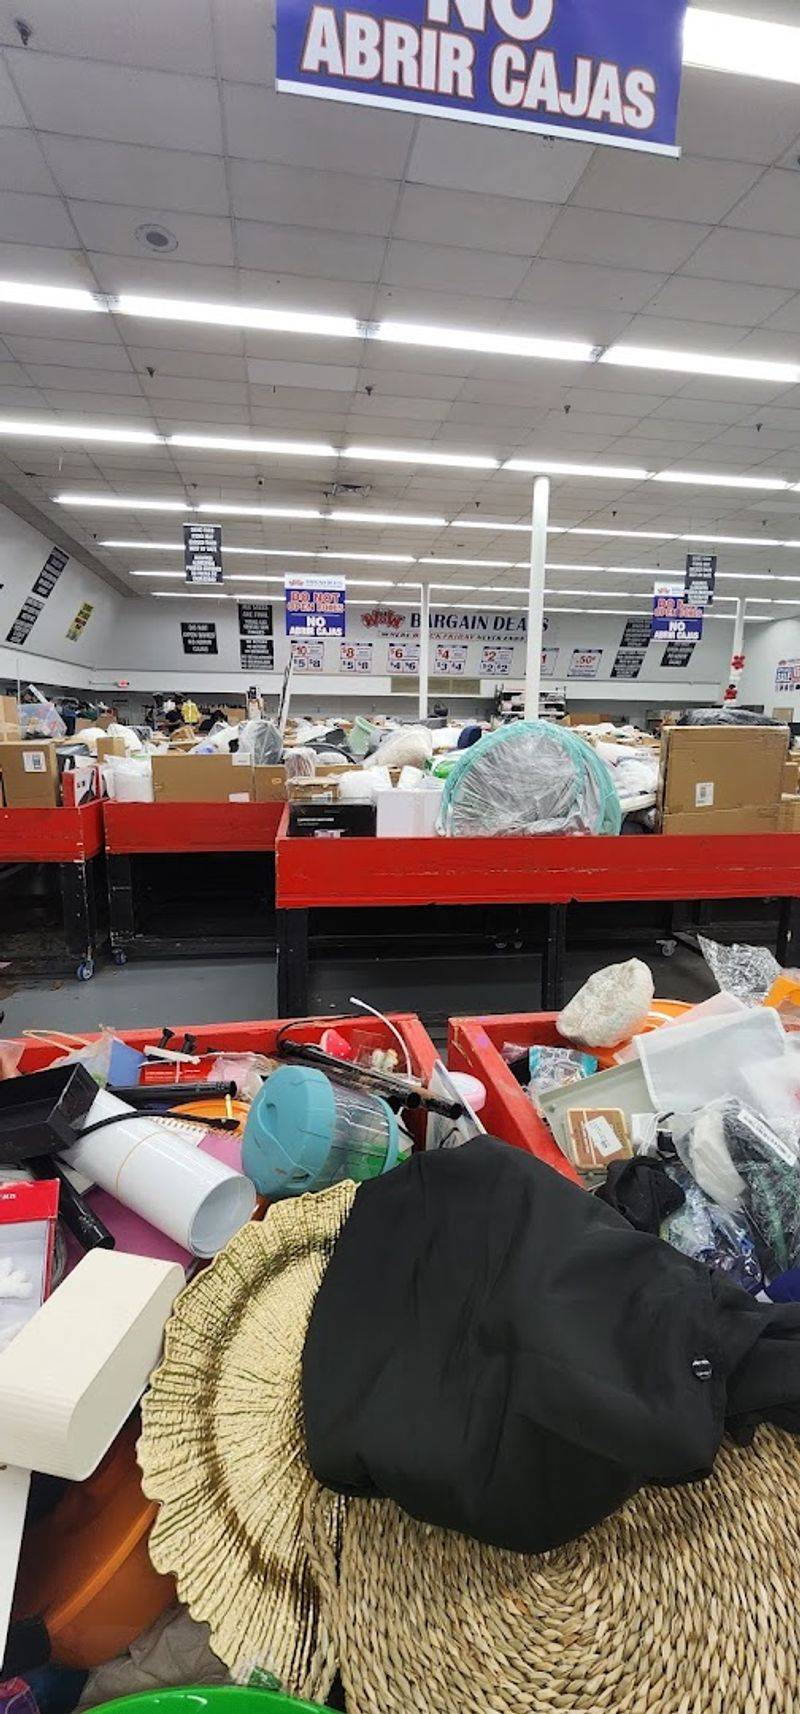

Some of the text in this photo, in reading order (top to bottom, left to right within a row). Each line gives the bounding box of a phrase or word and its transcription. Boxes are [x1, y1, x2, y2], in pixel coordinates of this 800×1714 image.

[302, 6, 657, 130] ABRIR CAJAS
[290, 591, 340, 603] DO NOT
[306, 616, 327, 627] NO
[410, 612, 488, 630] BRGAIN
[493, 616, 549, 632] DEAS
[668, 621, 686, 632] NO
[391, 648, 403, 659] $6
[438, 649, 449, 659] $4
[484, 651, 497, 662] $2
